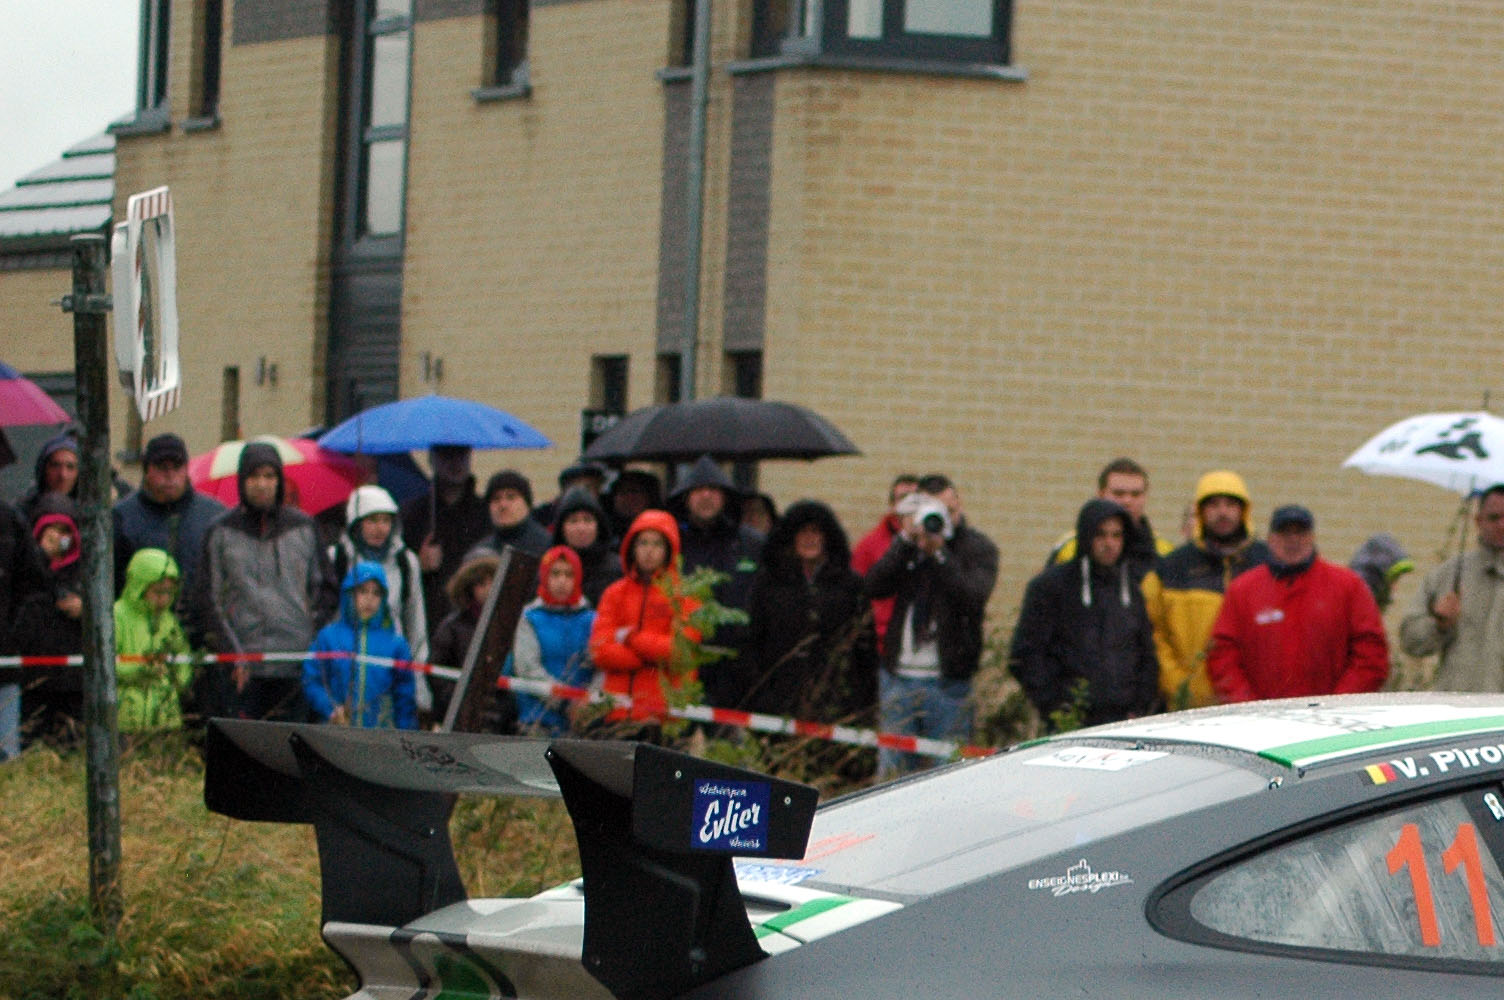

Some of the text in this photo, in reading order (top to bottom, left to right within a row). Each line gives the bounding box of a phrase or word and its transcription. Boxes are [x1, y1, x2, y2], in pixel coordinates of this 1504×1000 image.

[1390, 756, 1430, 779] V.
[699, 799, 761, 844] Evlier
[1385, 823, 1497, 947] 11
